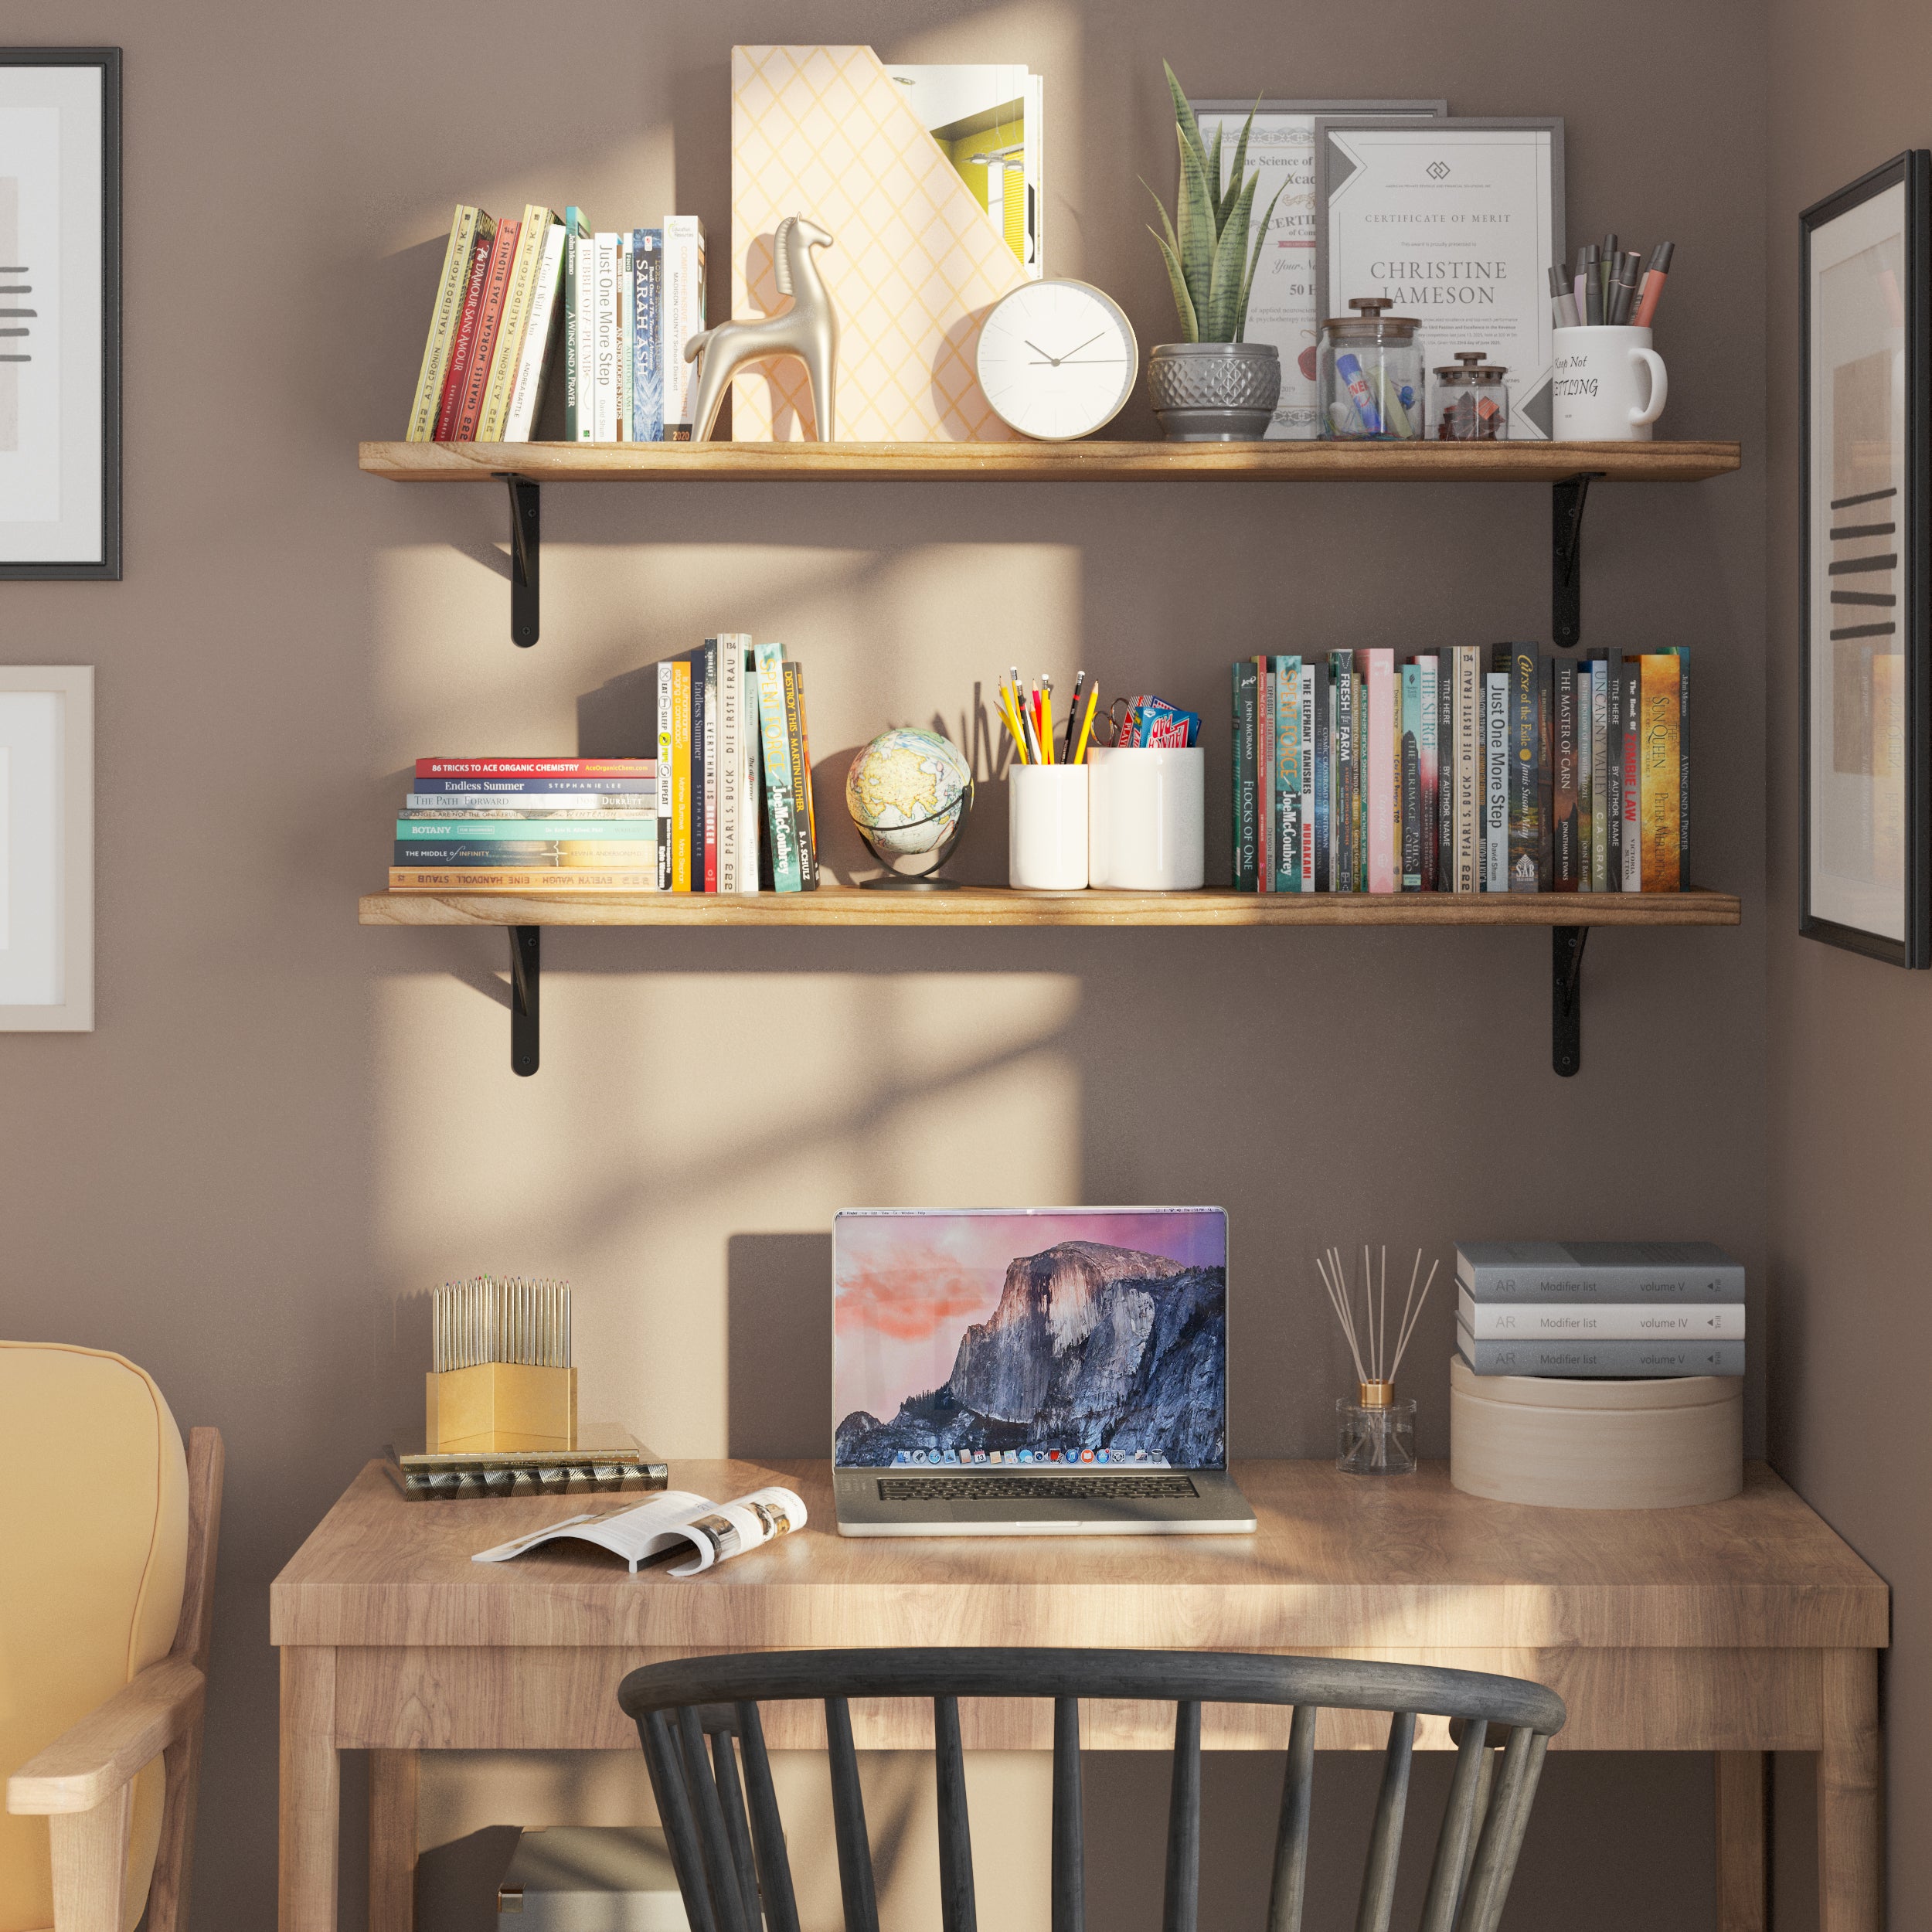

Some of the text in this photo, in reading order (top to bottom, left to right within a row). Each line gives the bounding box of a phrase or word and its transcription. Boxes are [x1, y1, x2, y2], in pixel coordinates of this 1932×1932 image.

[1259, 156, 1312, 165] Science of
[1370, 261, 1507, 279] CHRISTINE
[438, 260, 459, 335] KALEIDOSKOP
[508, 260, 529, 335] KALEIDOSKOP
[1290, 284, 1304, 295] 50
[1383, 287, 1495, 304] JAMESON
[468, 241, 510, 410] CHARLES MORGAN DAS BILDNIS
[597, 245, 613, 386] Just One More Step
[636, 260, 648, 376] SARAH ASH
[454, 335, 470, 372] AMOUR
[1570, 355, 1587, 369] Not
[672, 430, 690, 441] 2020
[1561, 669, 1570, 691] THE
[695, 682, 703, 760] Endless Summer
[1280, 669, 1298, 777] SPENT FORCE
[1341, 673, 1350, 761] FRESH FARM
[1422, 669, 1436, 750] THE SURGE
[1561, 694, 1570, 736] MASTER
[1594, 671, 1607, 747] UNCANNY
[1653, 696, 1669, 723] SUN
[1520, 723, 1531, 747] Exile
[1561, 741, 1570, 756] OF
[1648, 724, 1668, 768] QUEEN
[432, 764, 441, 772] 86
[443, 764, 468, 772] TRICKS
[471, 764, 481, 772] TO
[483, 764, 497, 772] ACE
[499, 764, 534, 772] ORGANIC
[536, 764, 579, 773] CHEMISTRY
[725, 659, 735, 854] FRAU ERSTE DIE BUCK PEARL
[784, 671, 811, 879] DESTROY LUTHER SCHULZ
[1443, 766, 1451, 777] BY
[1461, 669, 1472, 856] FRAU ERSTE DIE BUCK PEARL
[1488, 685, 1505, 828] Just One More Step
[1561, 758, 1570, 789] CARN
[1594, 750, 1607, 798] VALLEY
[1611, 679, 1620, 847] TITLE HERE BY AUTHOR NAME
[1624, 733, 1637, 787] ZOMBIE
[445, 781, 481, 791] Endless
[483, 781, 525, 791] Summer
[1243, 700, 1254, 870] JOHN MORANO FLOCKS OF ONE
[1302, 678, 1311, 879] THE ELEPHANT VANISHES MURAKAMI
[414, 796, 509, 805] THE PATH FORWARD
[1624, 791, 1637, 822] LAW
[1655, 793, 1669, 821] PETER
[706, 805, 715, 844] BROKEN
[1404, 827, 1413, 872] COELHO
[1411, 832, 1420, 867] PAULO
[417, 875, 613, 884] STAUB HANDVOLL EINE WAUGH EVELYN
[1495, 1280, 1515, 1292] AR
[1540, 1281, 1580, 1292] Modifier
[1583, 1281, 1597, 1292] list
[1640, 1281, 1675, 1292] volume
[1677, 1281, 1685, 1292] V
[1495, 1316, 1515, 1328] AR
[1540, 1317, 1580, 1328] Modifier
[1583, 1317, 1597, 1328] list
[1640, 1318, 1675, 1328] volume
[1677, 1318, 1688, 1328] IV
[1495, 1352, 1515, 1365] AR
[1540, 1353, 1580, 1365] Modifier
[1583, 1353, 1597, 1365] list
[1640, 1354, 1675, 1365] volume
[1677, 1354, 1685, 1365] V
